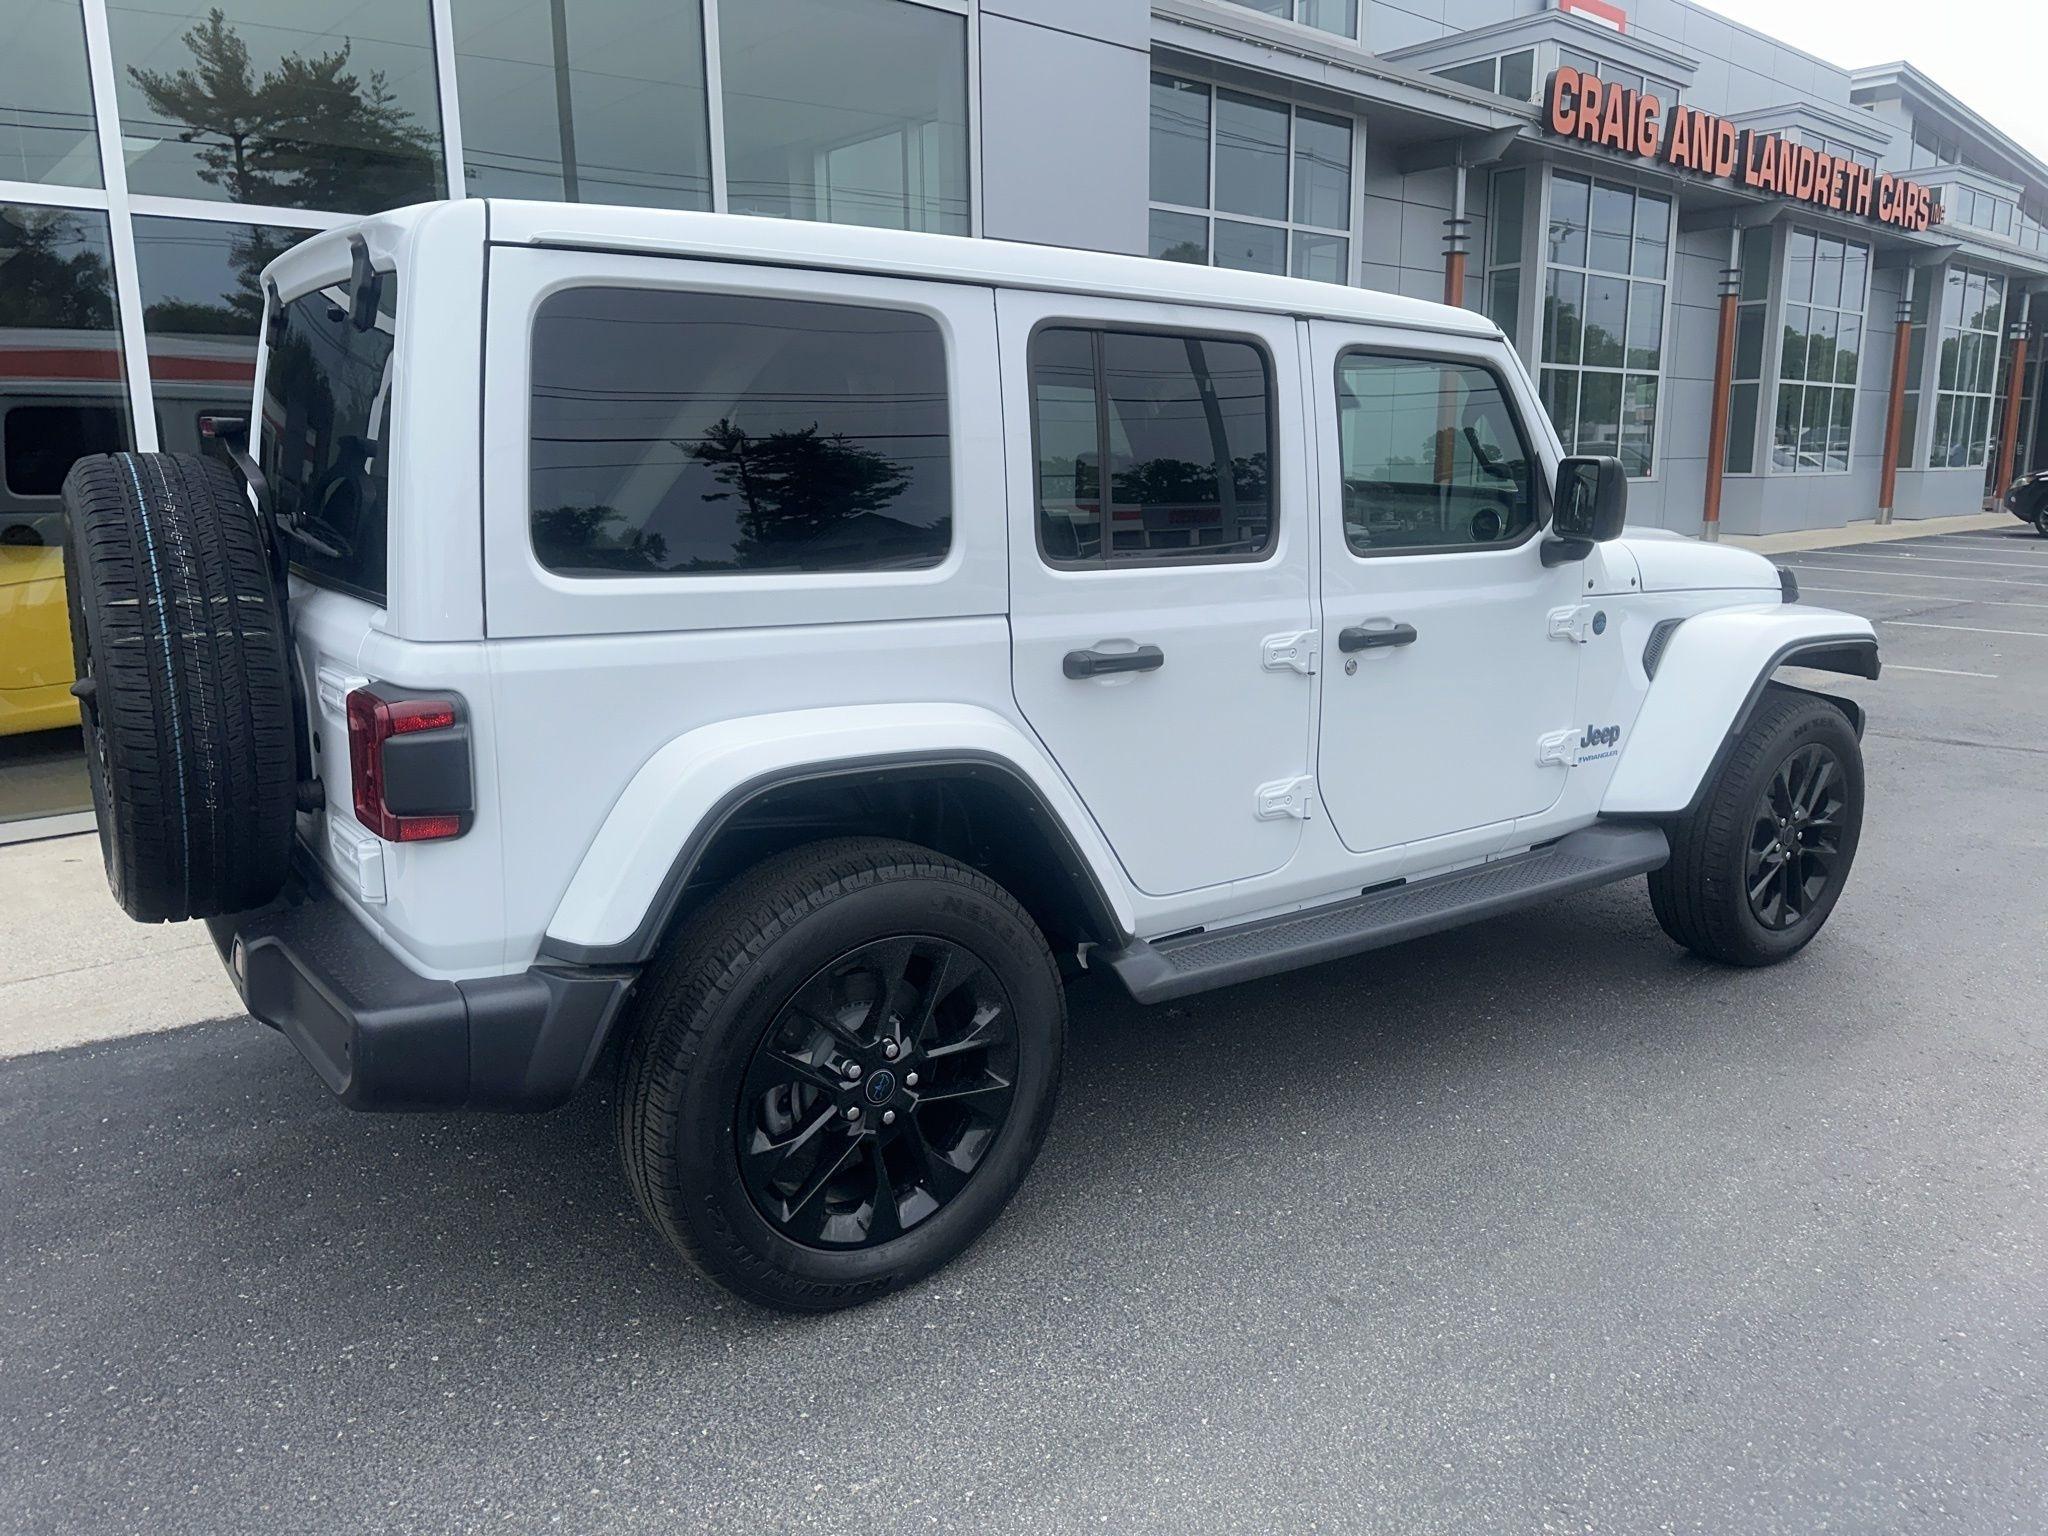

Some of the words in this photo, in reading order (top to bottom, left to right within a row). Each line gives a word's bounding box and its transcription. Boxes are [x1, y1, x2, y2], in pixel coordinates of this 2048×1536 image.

[1549, 65, 1661, 158] CRAIG
[1668, 104, 1736, 178] AND
[1743, 128, 1874, 217] LANDRETH
[1877, 172, 1930, 232] CARS
[1580, 724, 1620, 748] Jeep
